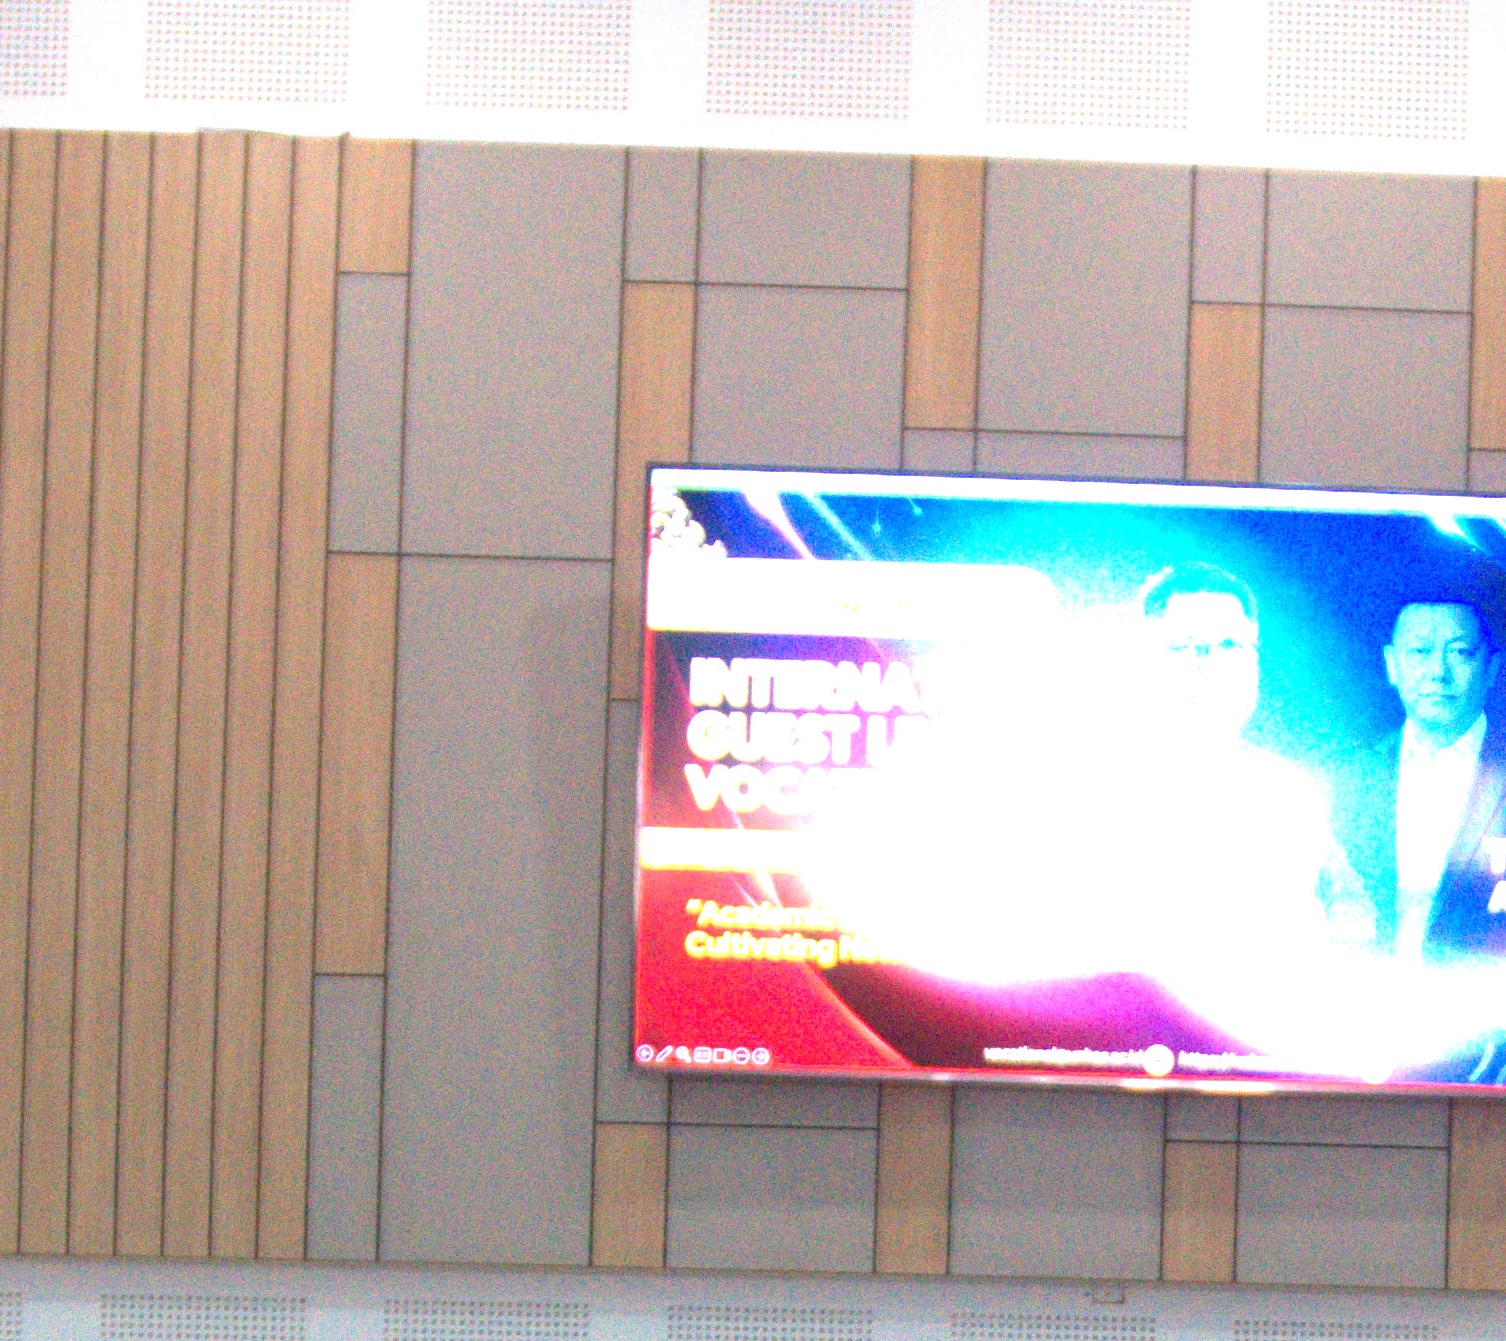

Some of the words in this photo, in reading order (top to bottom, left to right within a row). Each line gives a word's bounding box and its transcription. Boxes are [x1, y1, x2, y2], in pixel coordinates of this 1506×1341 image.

[689, 656, 926, 712] INTERNA
[686, 709, 862, 764] GUEST
[685, 931, 837, 970] Cultivating
